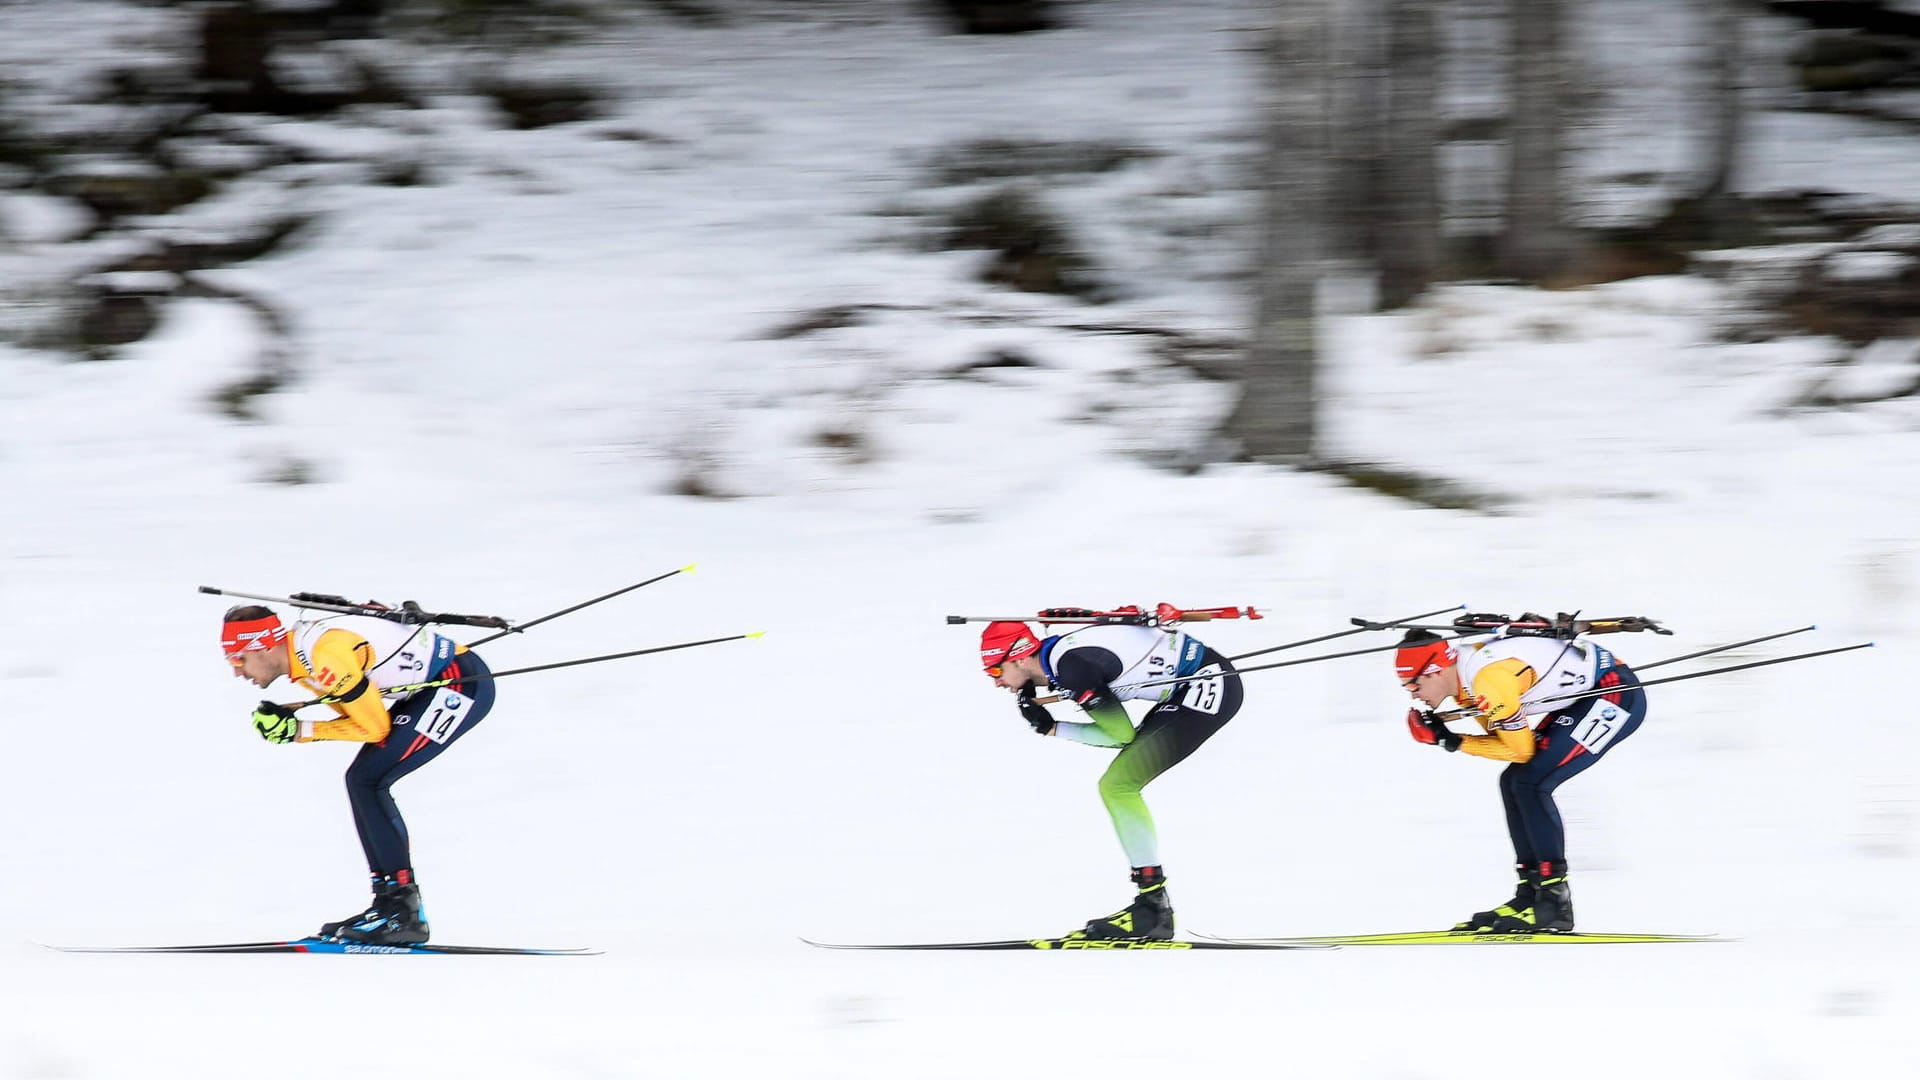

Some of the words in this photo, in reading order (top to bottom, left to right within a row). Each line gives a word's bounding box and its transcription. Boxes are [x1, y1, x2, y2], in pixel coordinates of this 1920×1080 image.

[399, 651, 414, 671] 14
[1149, 656, 1164, 677] 15
[1560, 670, 1576, 686] 17
[1194, 682, 1216, 710] 15
[427, 708, 455, 739] 14
[1582, 719, 1611, 747] 17
[1062, 940, 1192, 950] FISCHER
